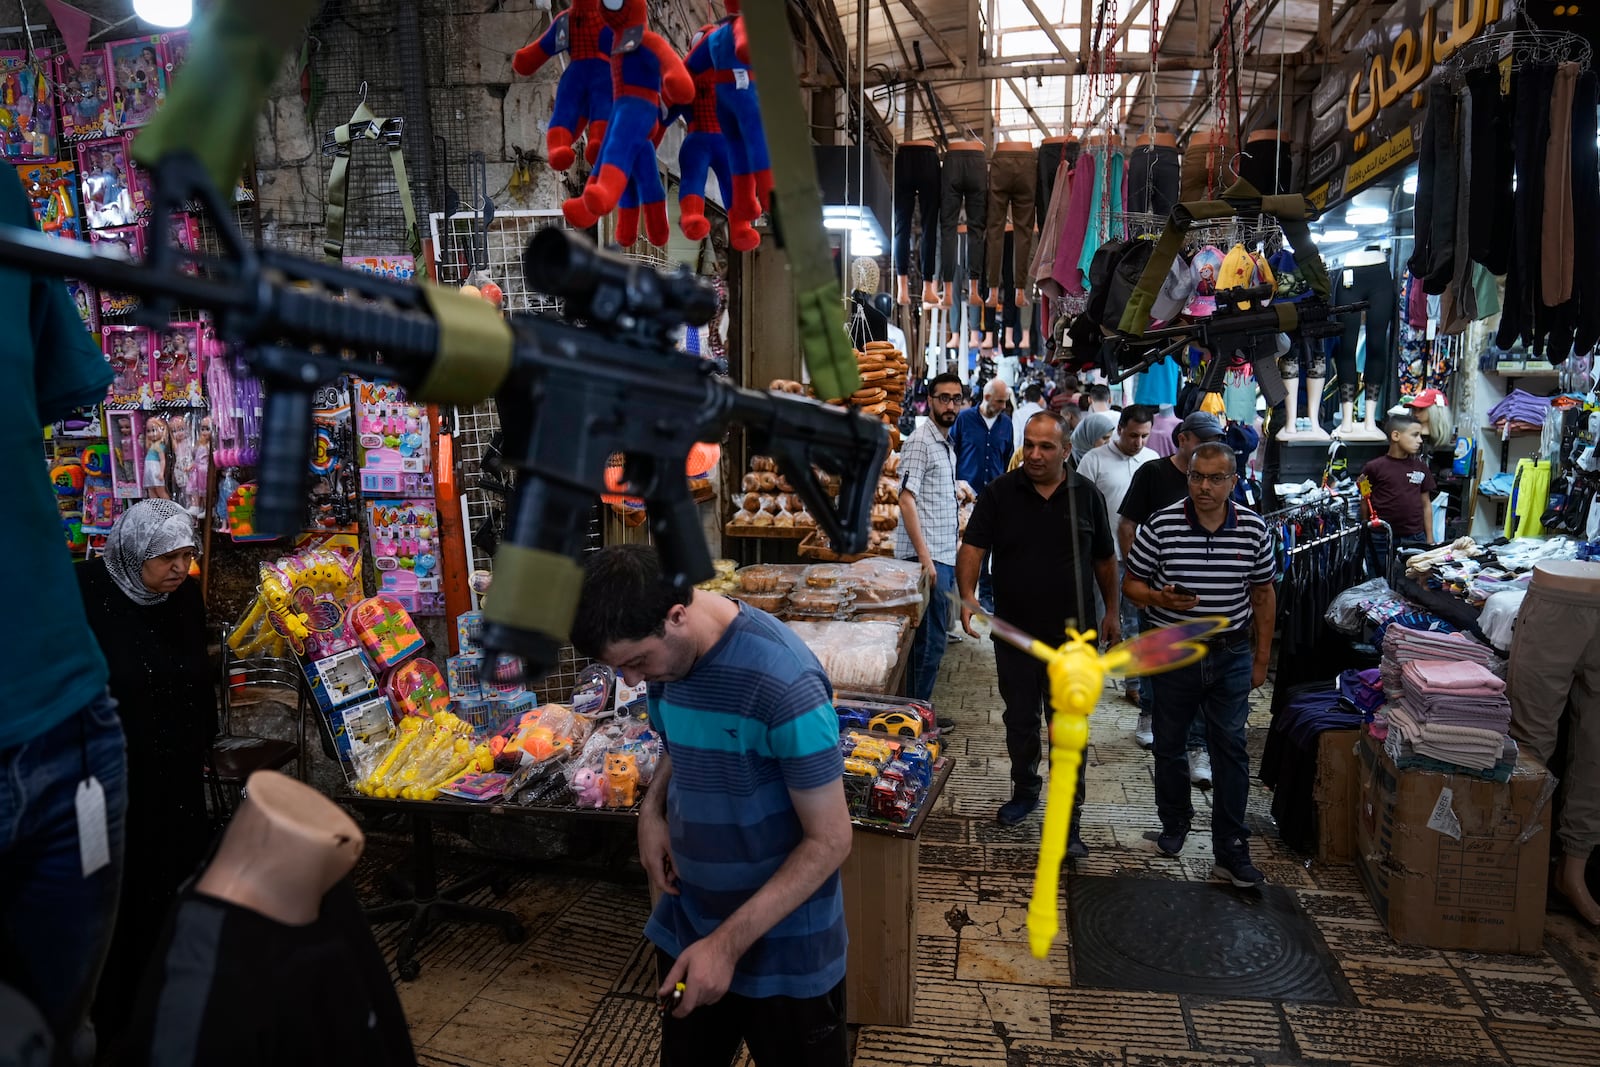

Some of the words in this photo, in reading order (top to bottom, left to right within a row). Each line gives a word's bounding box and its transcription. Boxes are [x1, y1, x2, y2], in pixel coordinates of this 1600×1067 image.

[0, 59, 17, 67] UTE
[74, 120, 103, 135] BEAUTY
[360, 383, 407, 406] Kitch
[1433, 795, 1449, 821] YASER
[1441, 913, 1467, 922] MADE
[1467, 915, 1478, 923] IN
[1478, 916, 1505, 925] CHINA
